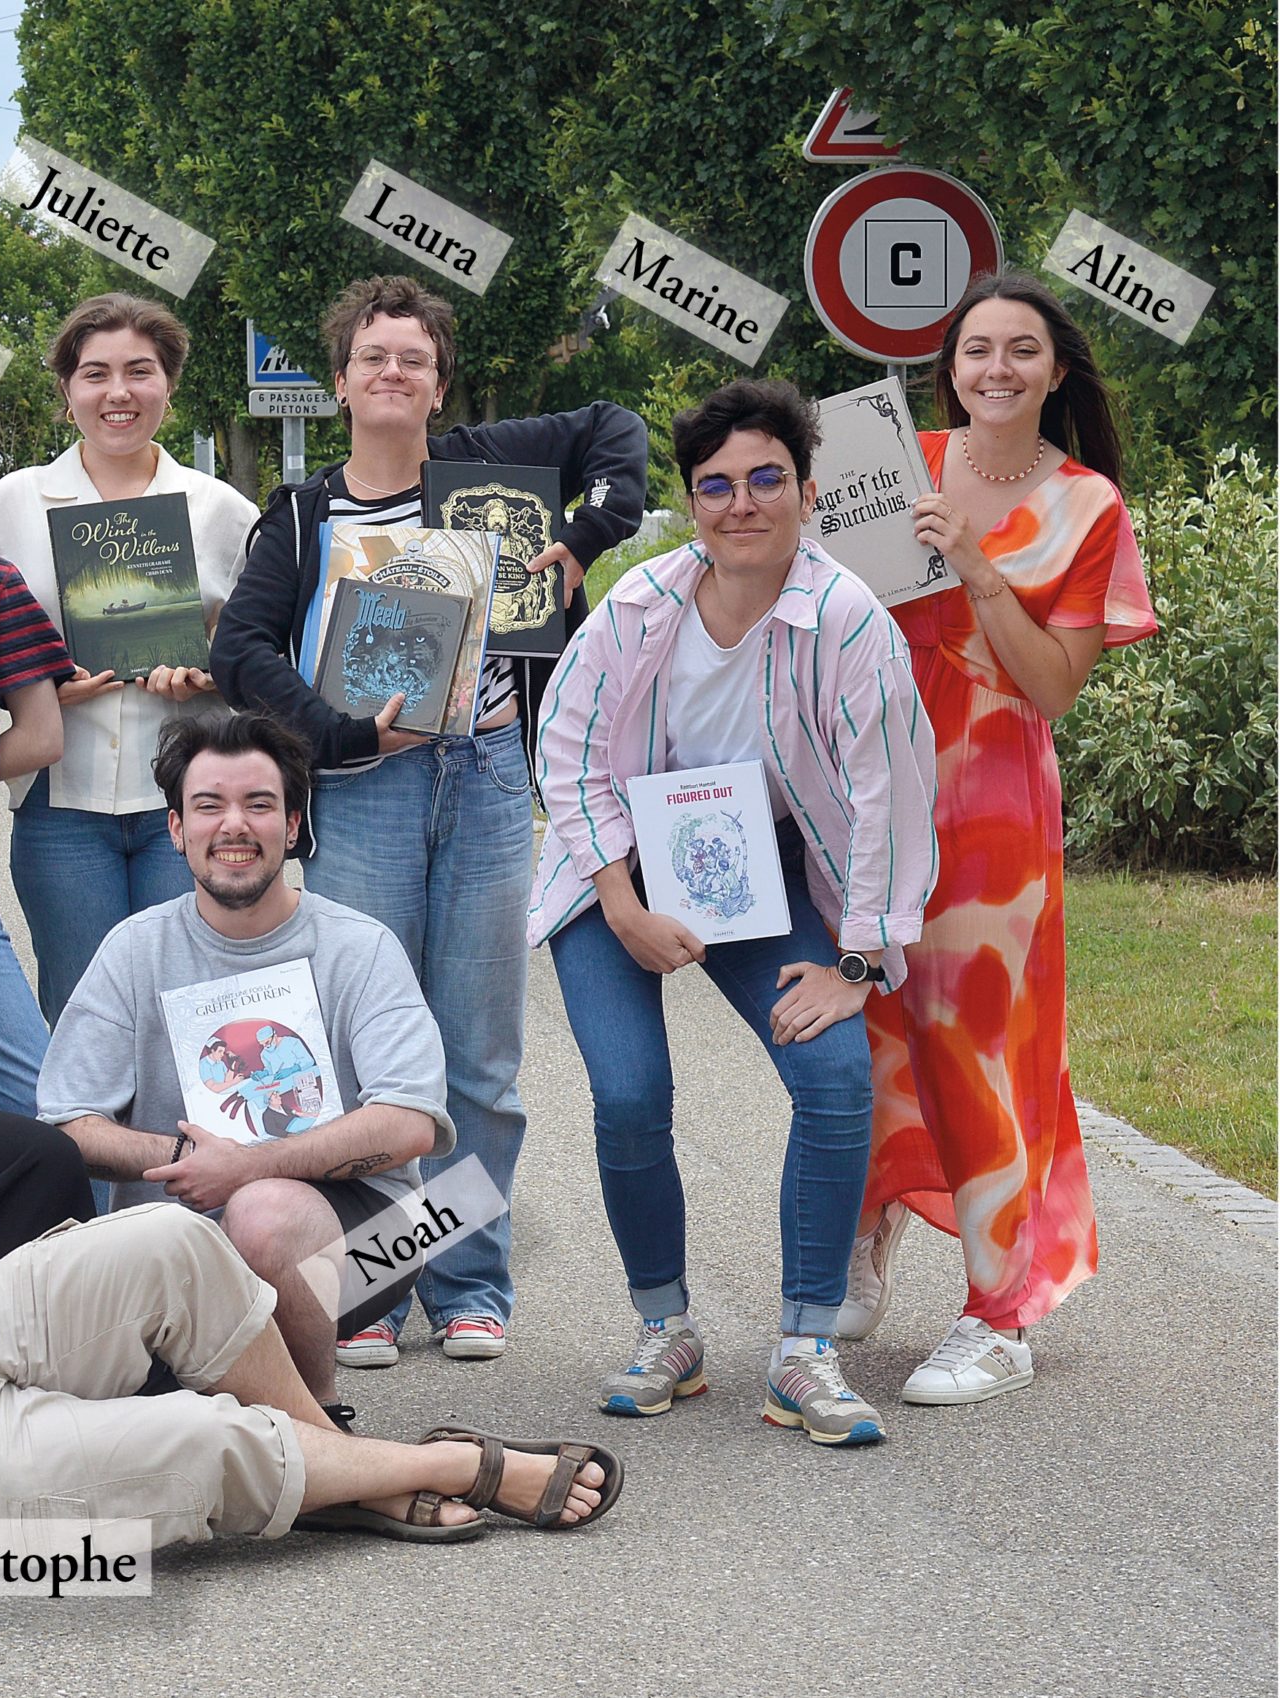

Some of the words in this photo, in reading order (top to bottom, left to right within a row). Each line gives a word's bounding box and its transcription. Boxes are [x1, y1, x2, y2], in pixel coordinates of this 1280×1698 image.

[891, 243, 921, 286] C
[259, 394, 264, 402] 6
[270, 394, 328, 402] PASSAGES
[269, 405, 318, 414] PIETONS
[840, 470, 856, 480] THE
[848, 472, 867, 504] of
[872, 465, 902, 495] the
[114, 512, 131, 525] The
[72, 518, 138, 546] Wind
[100, 537, 179, 565] Willows
[667, 789, 710, 805] FIGURED
[713, 786, 732, 798] OUT
[240, 993, 261, 1006] DU
[263, 985, 291, 1000] REIN
